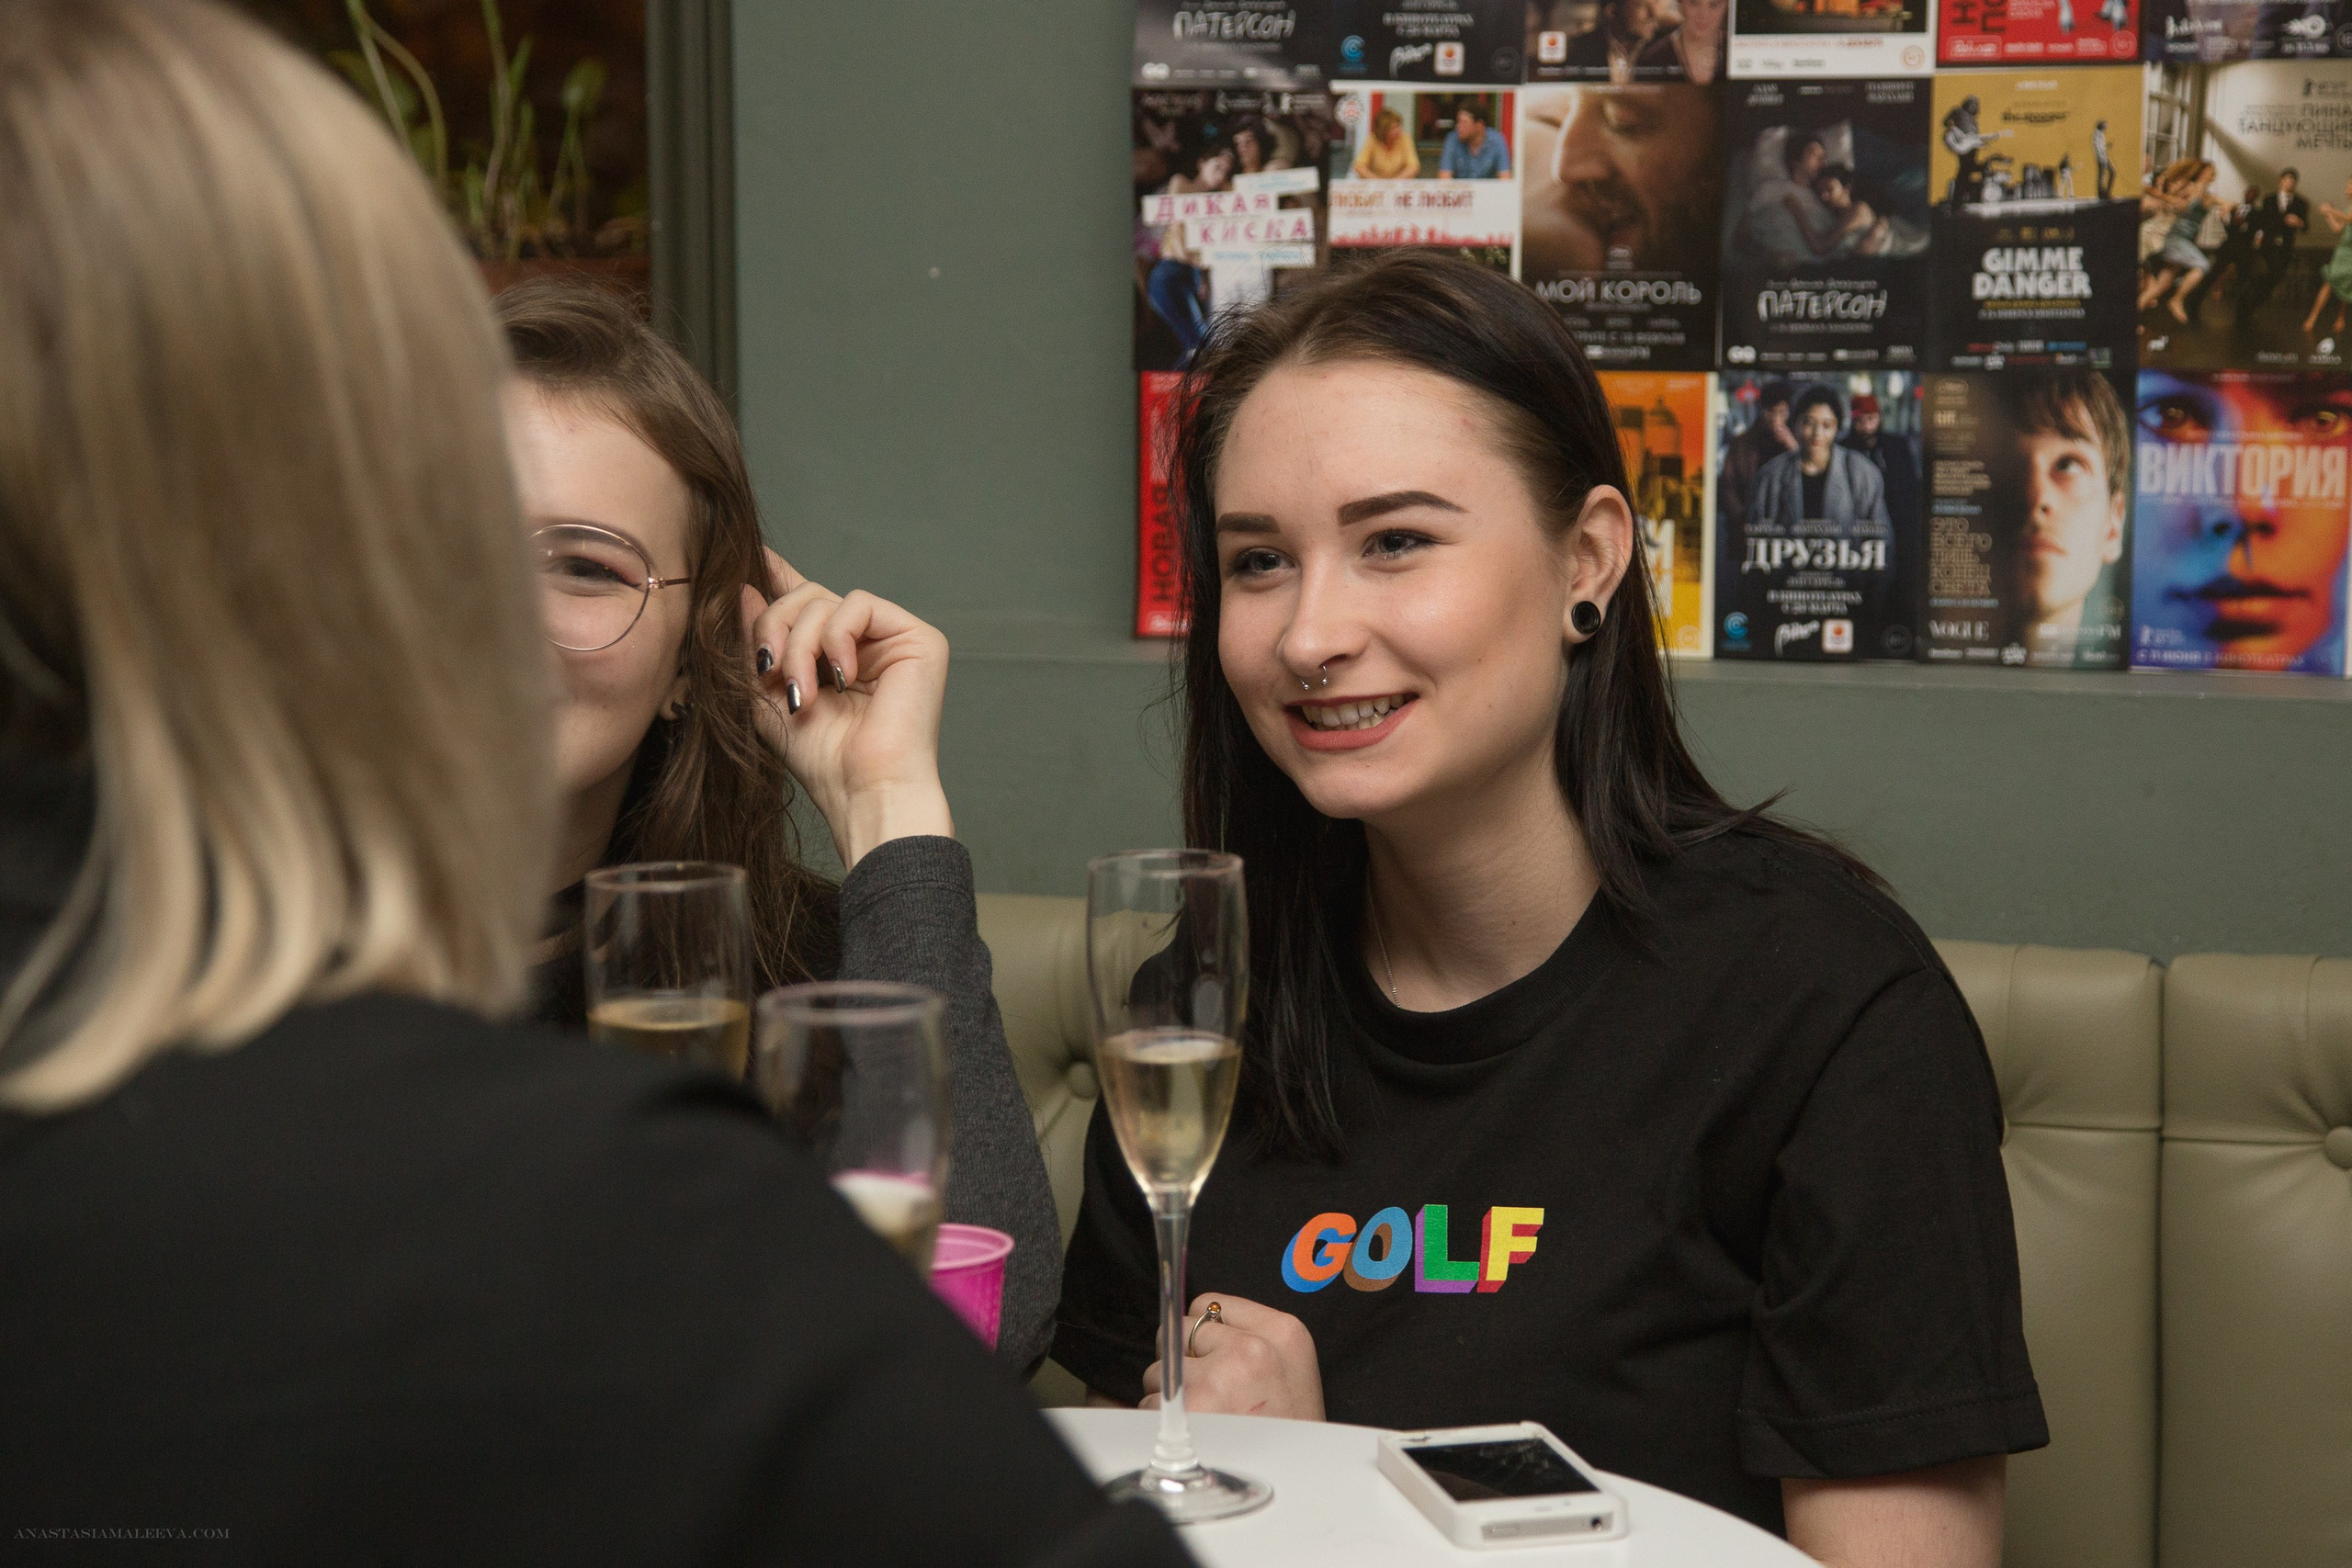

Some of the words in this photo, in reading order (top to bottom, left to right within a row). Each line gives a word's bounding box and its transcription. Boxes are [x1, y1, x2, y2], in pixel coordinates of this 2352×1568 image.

[1172, 9, 1296, 41] ПАТЕРСОН
[1155, 193, 1271, 221] ДИКАЯ
[1201, 217, 1307, 243] КИСКА
[1981, 246, 2085, 274] GIMME
[1535, 276, 1597, 304] МОЙ
[1600, 279, 1702, 305] КОРОЛЬ
[1972, 271, 2093, 300] DANGER
[1758, 288, 1888, 321] ПАТЕРСОН
[2139, 442, 2347, 499] ВИКТОРИЯ
[1741, 537, 1887, 575] ДРУЗЬЯ
[1929, 620, 1989, 641] VOGUE
[1281, 1203, 1545, 1293] GOLF
